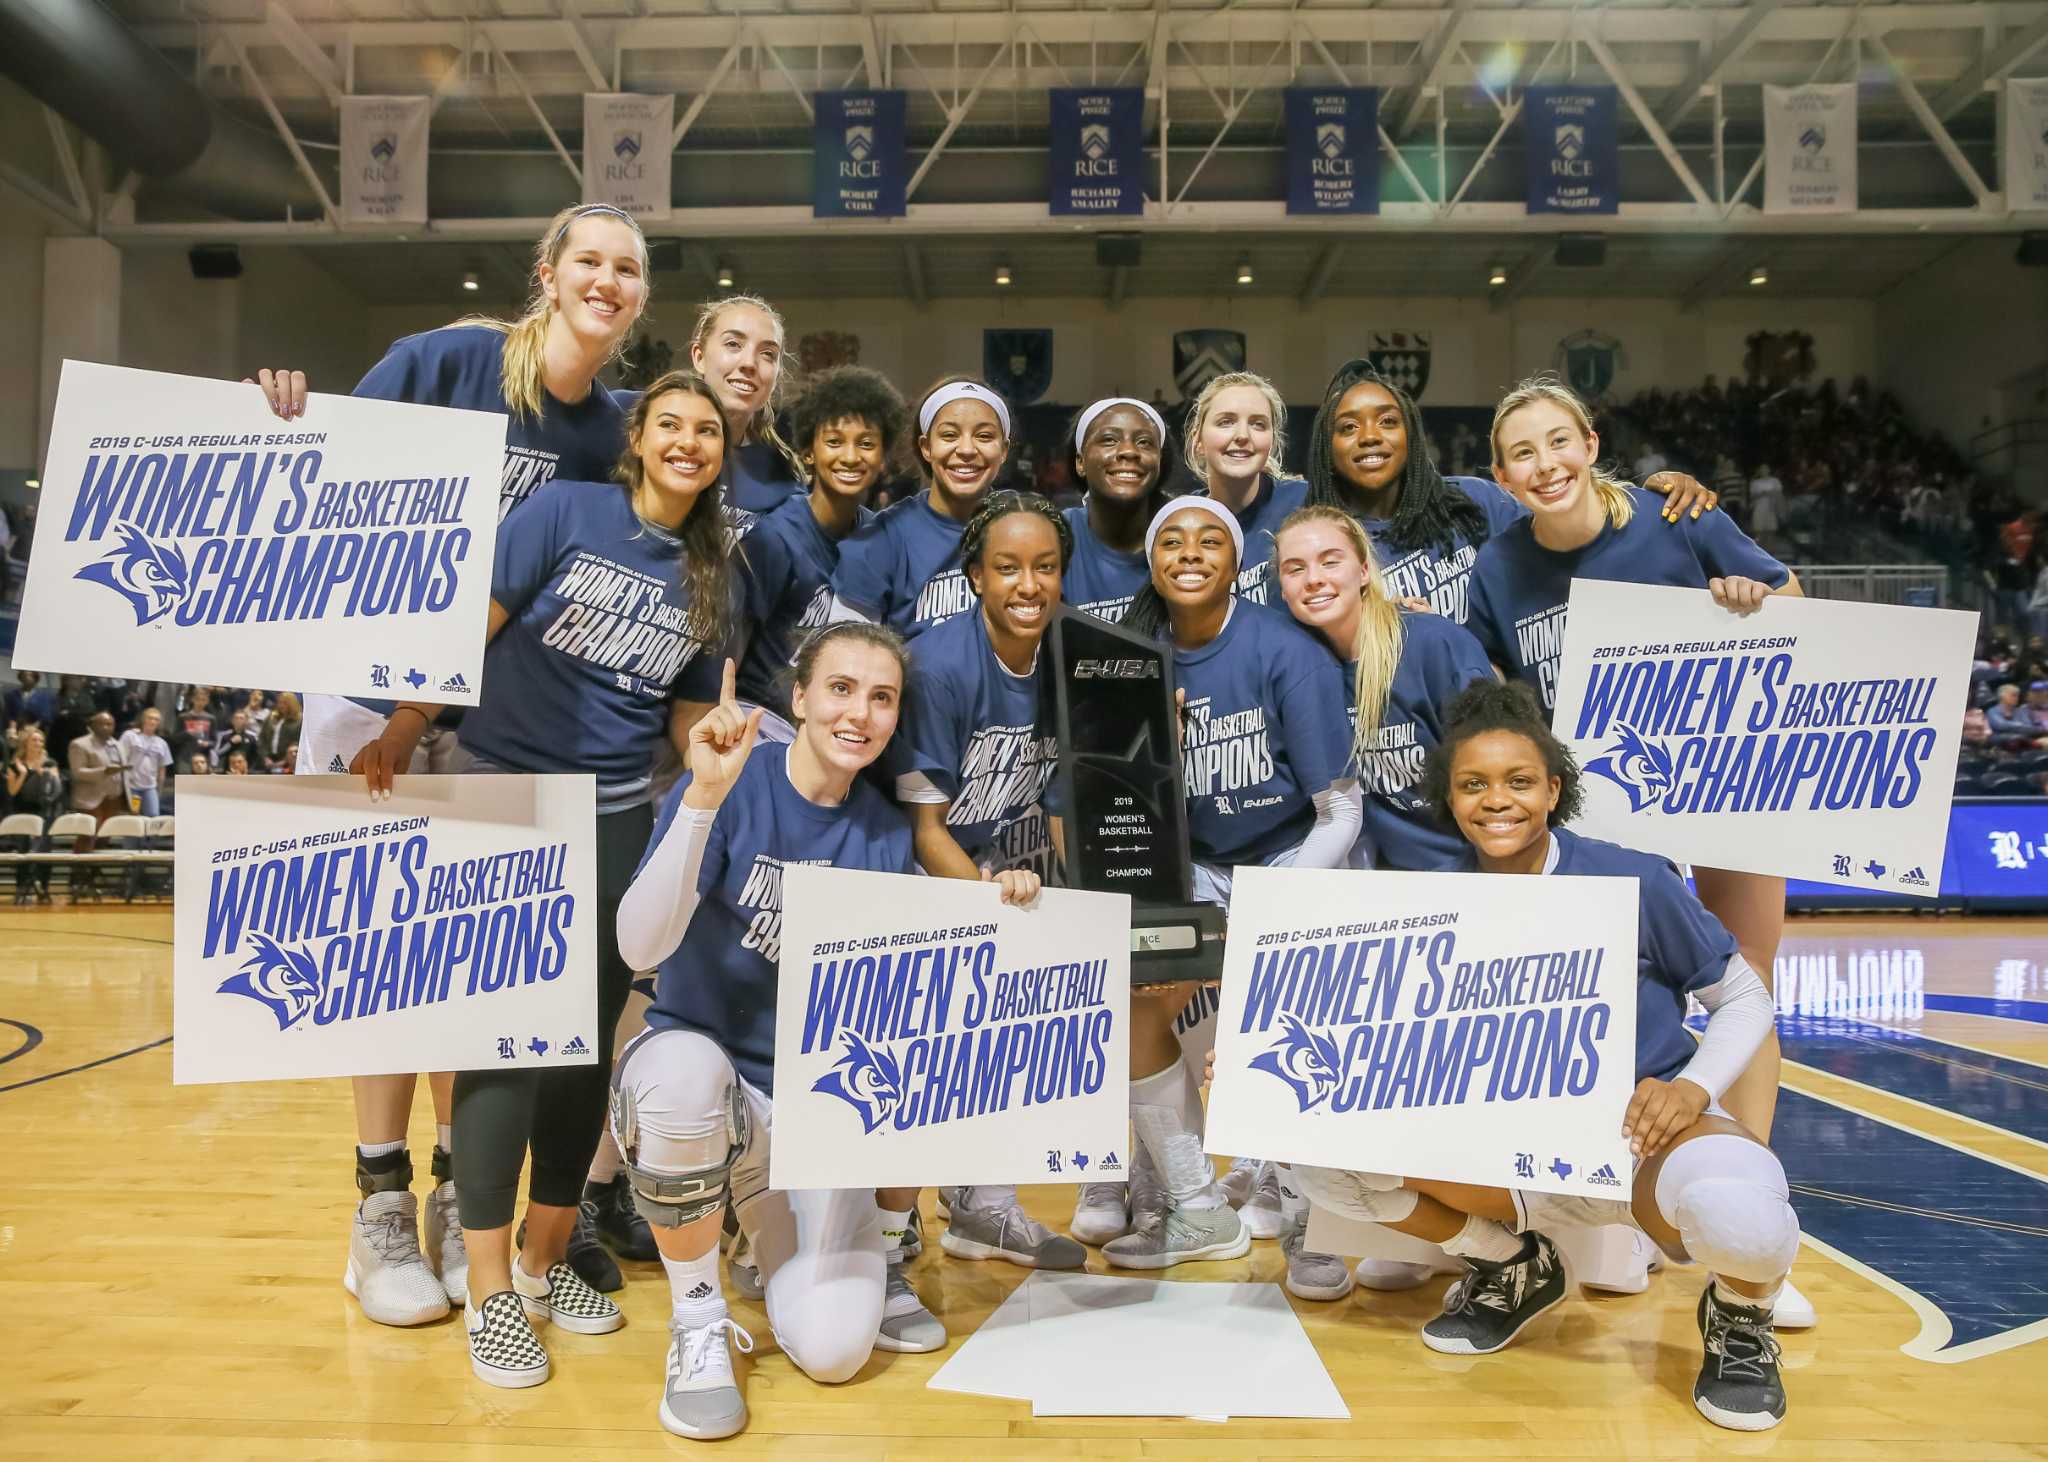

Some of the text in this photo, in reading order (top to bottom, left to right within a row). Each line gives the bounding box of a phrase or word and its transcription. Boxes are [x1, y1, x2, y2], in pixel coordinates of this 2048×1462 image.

[606, 163, 647, 181] RICE
[840, 160, 880, 177] RICE
[1075, 159, 1118, 176] RICE
[1312, 159, 1354, 175] RICE
[1551, 159, 1593, 176] RICE
[840, 190, 879, 199] ROBERT
[1071, 187, 1121, 197] RICHARD
[1313, 180, 1353, 189] ROBERT
[1314, 190, 1354, 200] WILSON
[1071, 198, 1119, 209] SMALLEY
[89, 432, 328, 449] 2019 C-USA REGULAR SEASON
[64, 450, 470, 541] WOMEN'S BASKETBALL
[174, 527, 472, 626] CHAMPIONS
[555, 560, 664, 623] WOMEN'S
[1592, 636, 1798, 659] 2019 C-USA REGULAR SEASON
[371, 664, 390, 688] R
[1074, 658, 1160, 680] C-USA
[440, 684, 471, 693] adidas
[1574, 653, 1793, 740] WOMEN'S
[1780, 677, 1938, 729] BASKETBALL
[1210, 706, 1266, 743] BASKETBALL
[1184, 730, 1274, 798] AMPIONS
[1662, 727, 1937, 815] CHAMPIONS
[1114, 797, 1133, 806] 2019
[1243, 795, 1285, 808] C-USA
[1104, 814, 1145, 824] WOMEN'S
[212, 816, 430, 864] 2019 C-USA REGULAR SEASON
[1099, 825, 1153, 836] BASKETBALL
[1106, 868, 1152, 878] CHAMPION
[1833, 855, 1851, 877] R
[1899, 877, 1930, 887] adidas
[202, 835, 567, 959] WOMEN'S BASKETBALL
[813, 922, 998, 956] 2019 C-USA REGULAR SEASON
[1140, 934, 1160, 945] RICE
[1256, 912, 1459, 946] 2019 C-USA REGULAR SEASON
[313, 894, 575, 1026] CHAMPIONS
[1239, 930, 1456, 1034] WOMEN'S
[1447, 948, 1605, 1013] BASKETBALL
[800, 941, 996, 1054] WOMEN'S
[990, 959, 1108, 1022] BASKETBALL
[497, 1037, 516, 1059] R
[561, 1047, 590, 1056] adidas
[1331, 1003, 1611, 1113] CHAMPIONS
[893, 1009, 1113, 1131] CHAMPIONS
[1047, 1150, 1063, 1173] R
[1099, 1162, 1122, 1170] adidas
[1515, 1152, 1534, 1179] R
[1587, 1175, 1622, 1187] adidas
